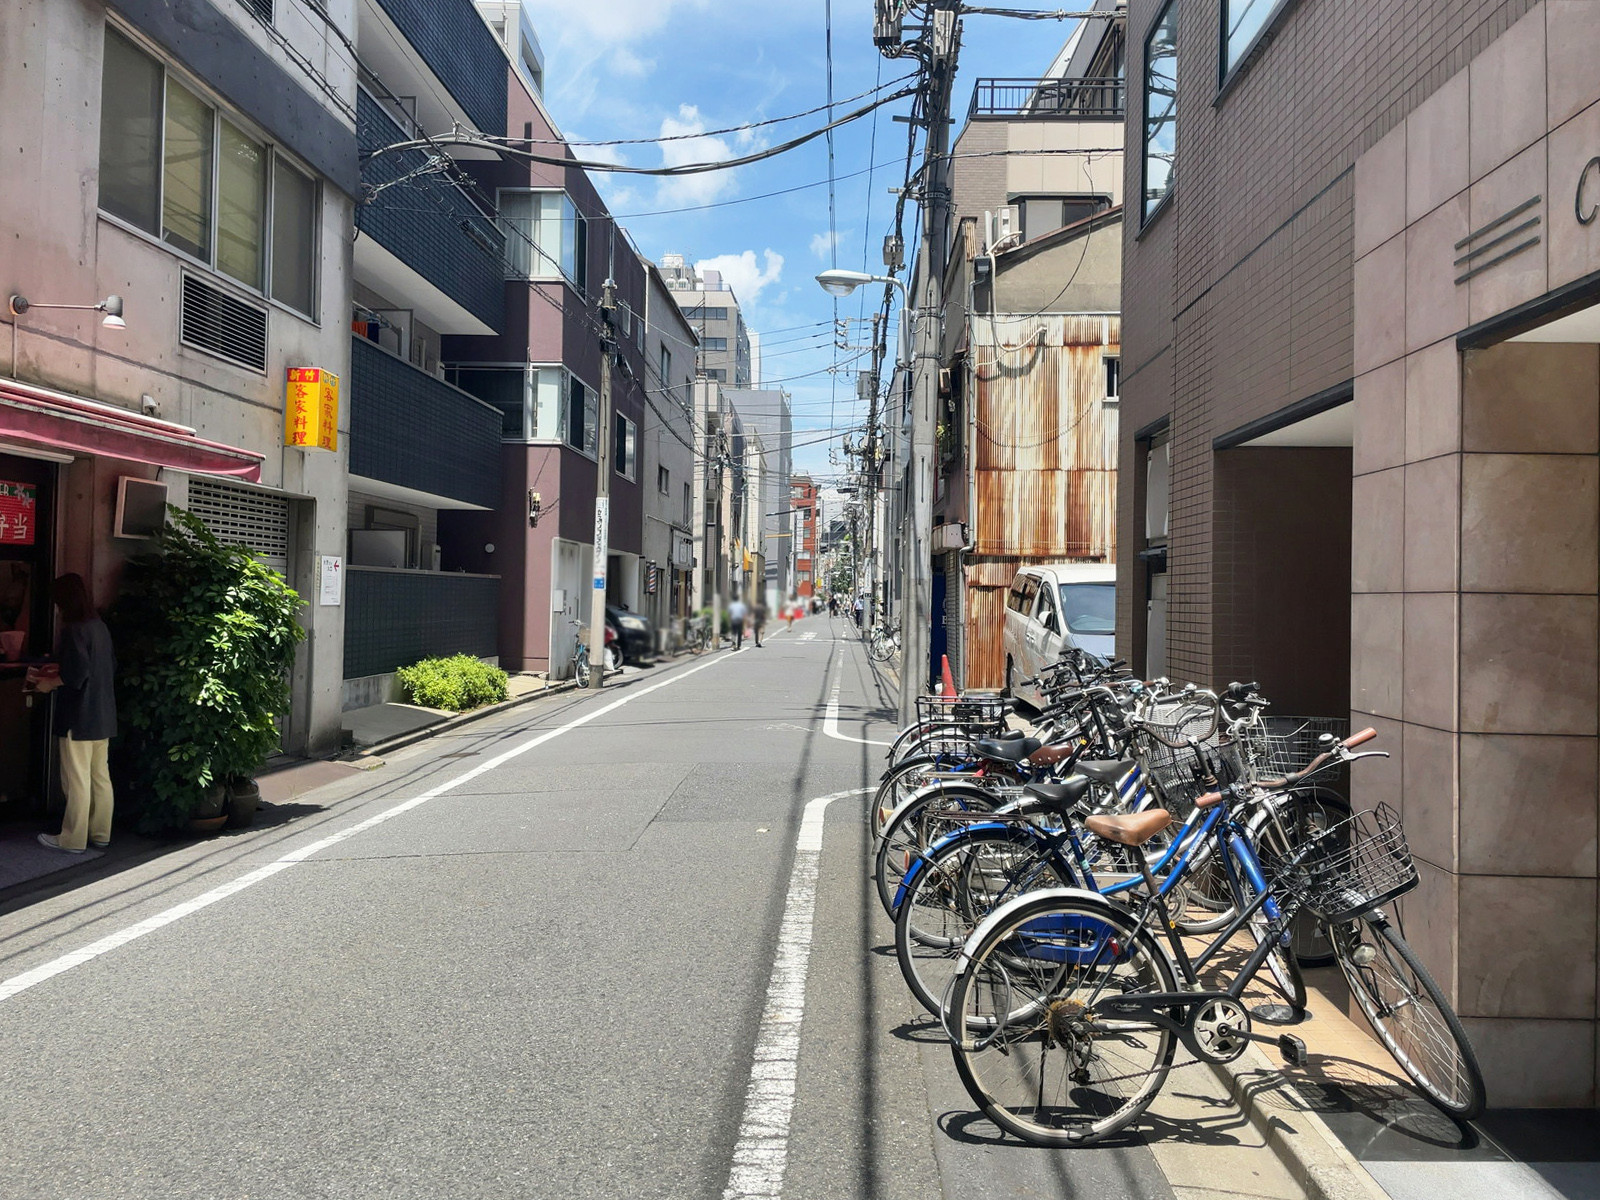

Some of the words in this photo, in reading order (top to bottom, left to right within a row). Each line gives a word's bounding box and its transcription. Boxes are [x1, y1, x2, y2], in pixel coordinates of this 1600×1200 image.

[292, 384, 308, 445] 客家料理
[322, 387, 334, 450] 客家料理
